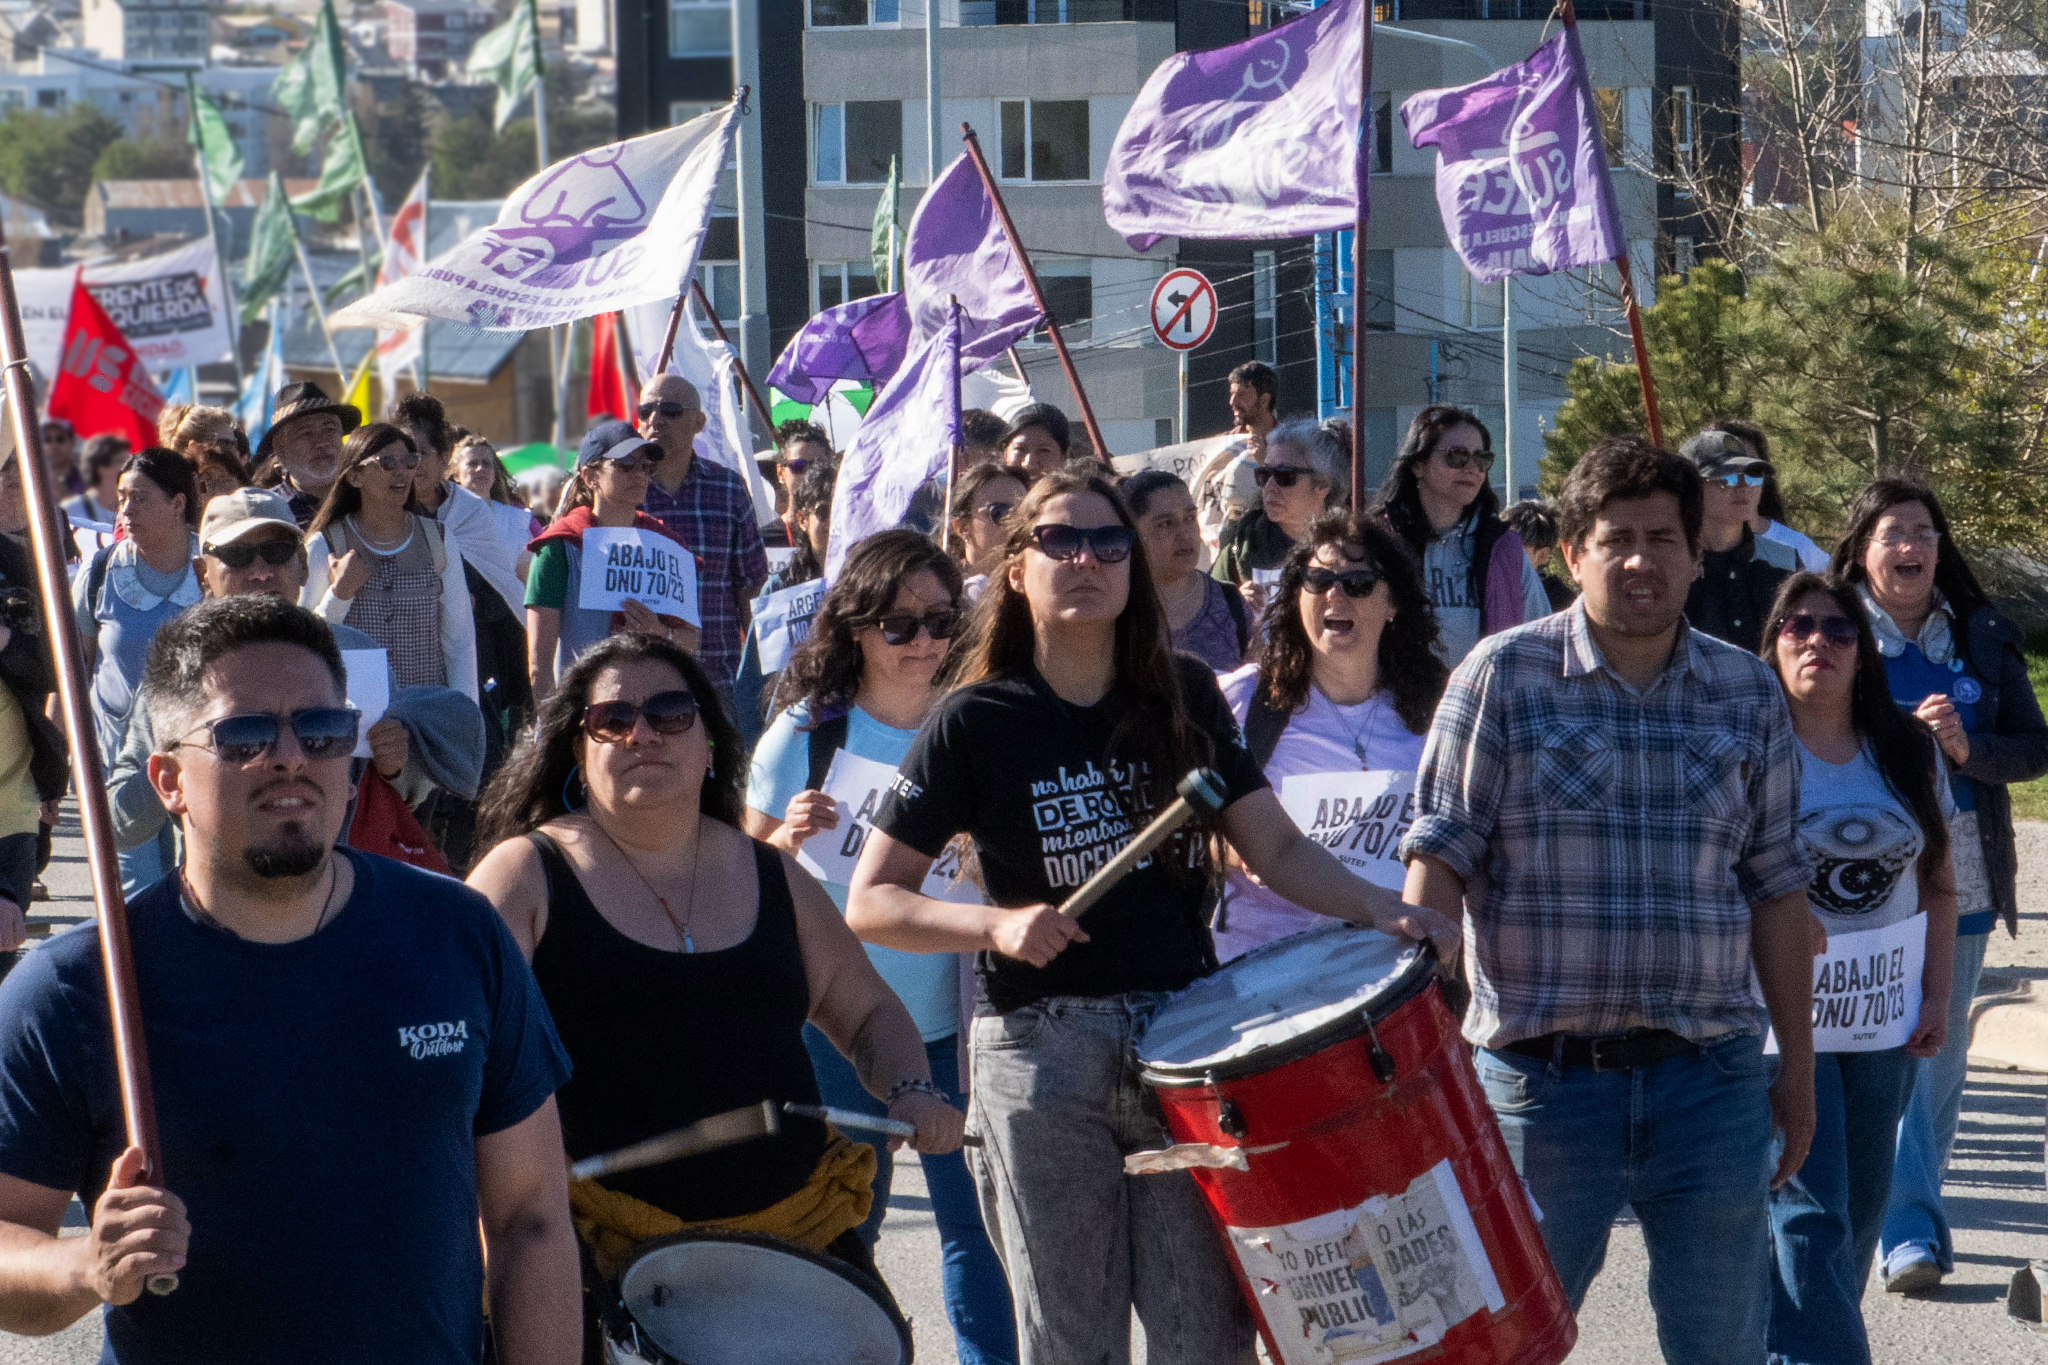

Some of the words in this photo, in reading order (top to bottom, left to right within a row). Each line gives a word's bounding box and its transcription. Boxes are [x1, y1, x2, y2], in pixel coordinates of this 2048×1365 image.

[109, 297, 208, 327] QUIERDA
[607, 543, 666, 571] ABAJO
[668, 554, 682, 580] EL
[605, 568, 642, 594] DNU
[647, 572, 685, 604] 70/23
[890, 773, 923, 799] TEF
[1032, 781, 1059, 797] no
[1311, 794, 1398, 830] ABAJO
[1398, 792, 1415, 824] E
[1349, 821, 1410, 862] 70/2
[1813, 952, 1887, 994] ABAJO
[1888, 946, 1904, 982] EL
[1811, 995, 1858, 1028] DNU
[1861, 982, 1904, 1027] 70/23
[399, 1020, 469, 1047] KODA
[410, 1037, 464, 1060] Outdoor
[1397, 1208, 1427, 1239] LAS
